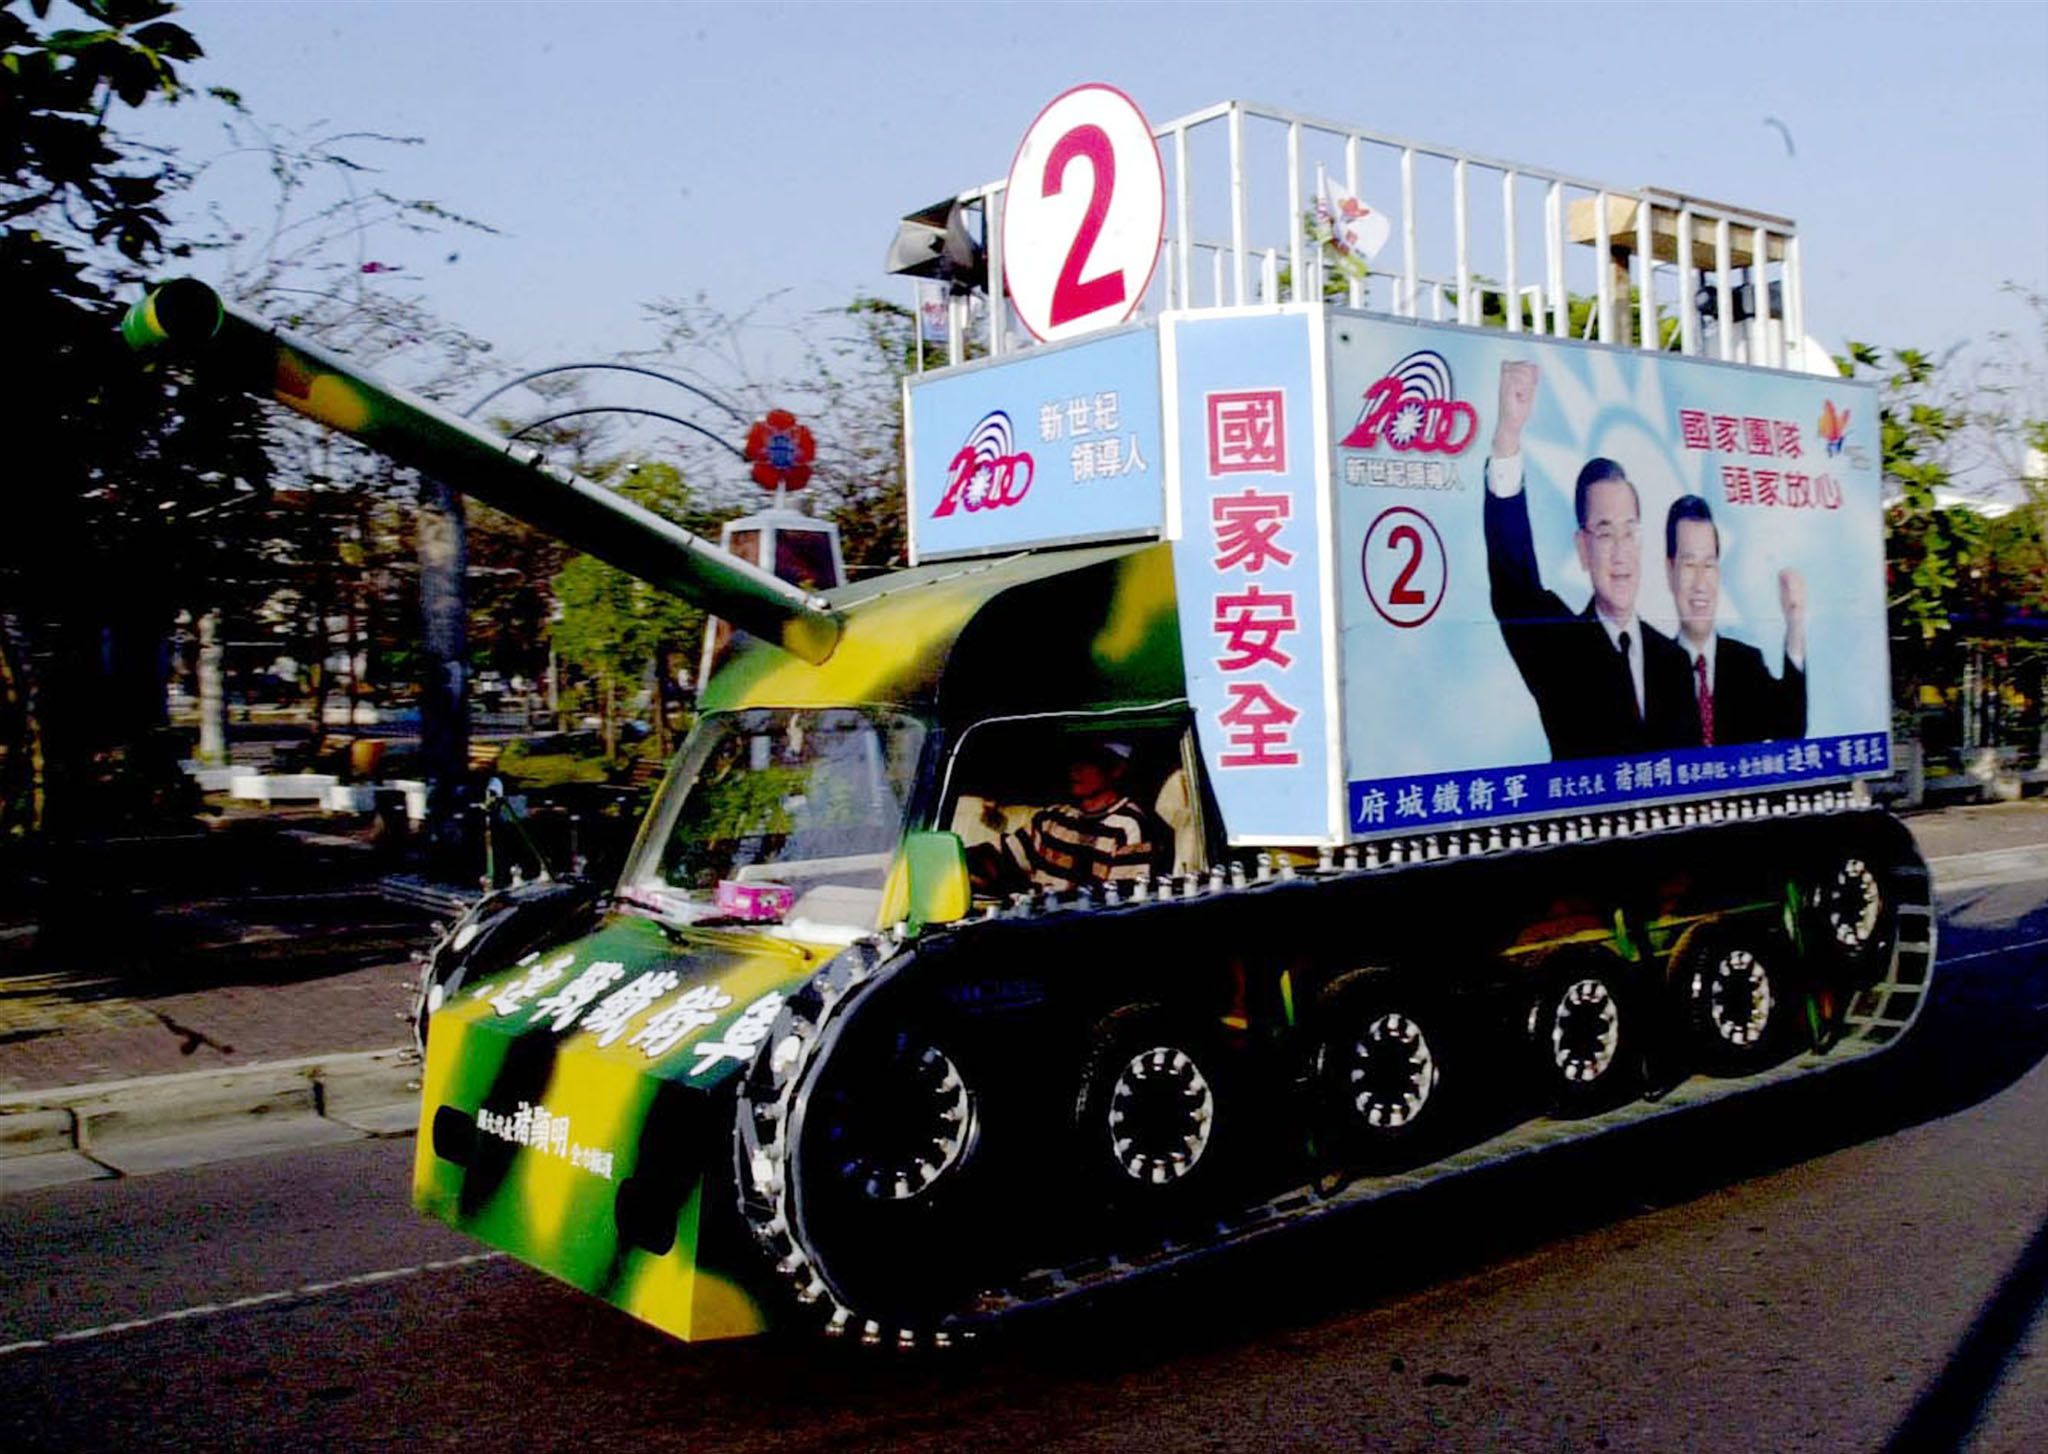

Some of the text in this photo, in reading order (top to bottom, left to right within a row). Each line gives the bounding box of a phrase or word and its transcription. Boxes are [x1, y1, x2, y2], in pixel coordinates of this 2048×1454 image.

[1042, 123, 1126, 328] 2
[1039, 391, 1119, 443] 新世紀
[1679, 409, 1804, 459] 國家團隊
[1070, 436, 1147, 484] 領導人
[1720, 465, 1843, 510] 頭家放心
[1206, 389, 1299, 768] 國家安全
[1387, 525, 1426, 605] 2
[1357, 773, 1529, 825] 府城鐵衛軍
